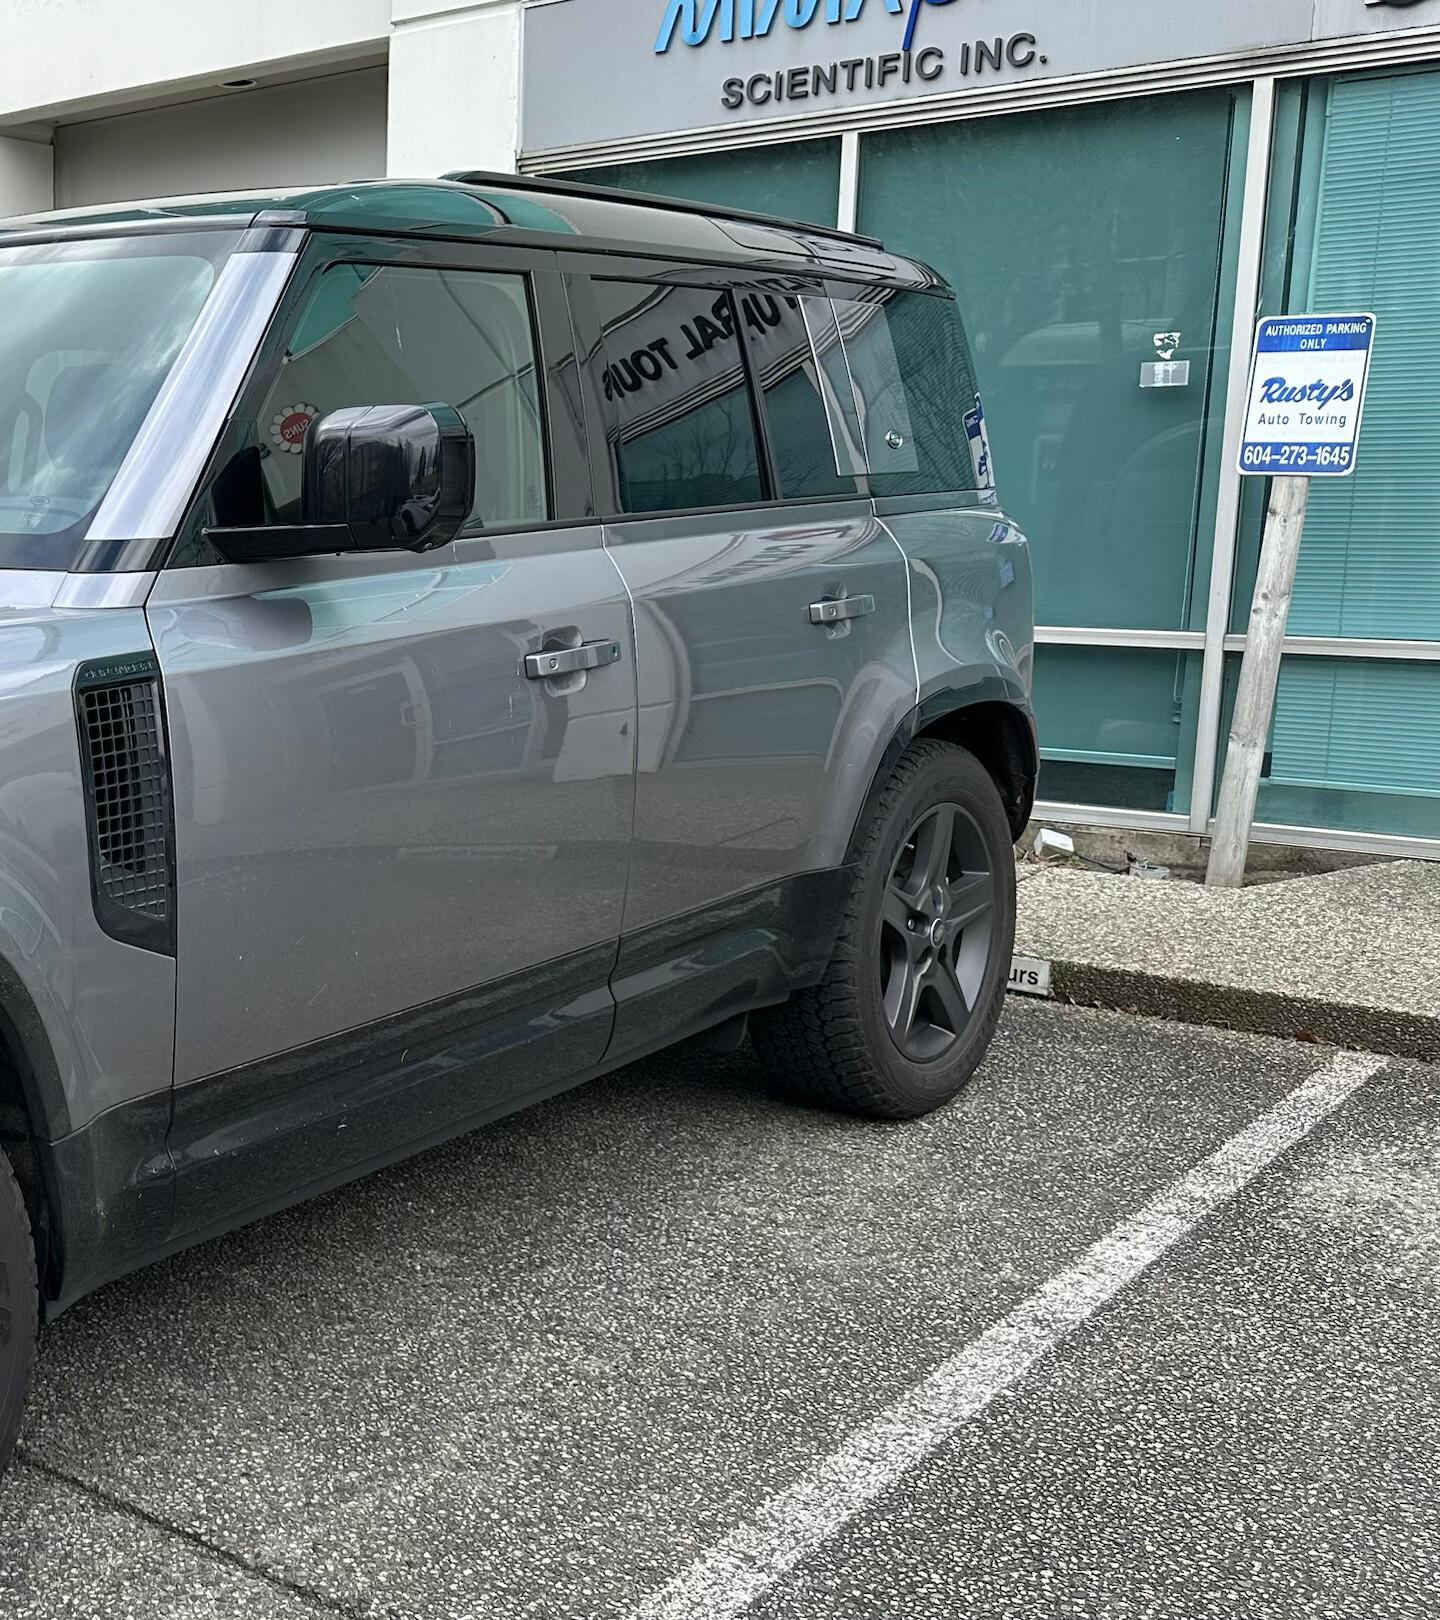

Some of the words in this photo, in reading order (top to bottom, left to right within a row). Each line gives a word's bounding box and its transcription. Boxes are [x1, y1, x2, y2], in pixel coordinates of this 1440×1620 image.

[720, 46, 944, 109] SCIENTIFIC
[960, 32, 1048, 76] INC.
[1265, 324, 1323, 336] AUTHORIZED
[1326, 322, 1367, 334] PARKING
[1300, 338, 1327, 349] ONLY
[1260, 377, 1354, 410] Rusty's
[1258, 413, 1290, 425] Auto
[1299, 413, 1347, 427] Towing
[1243, 446, 1350, 466] 604-273-1645
